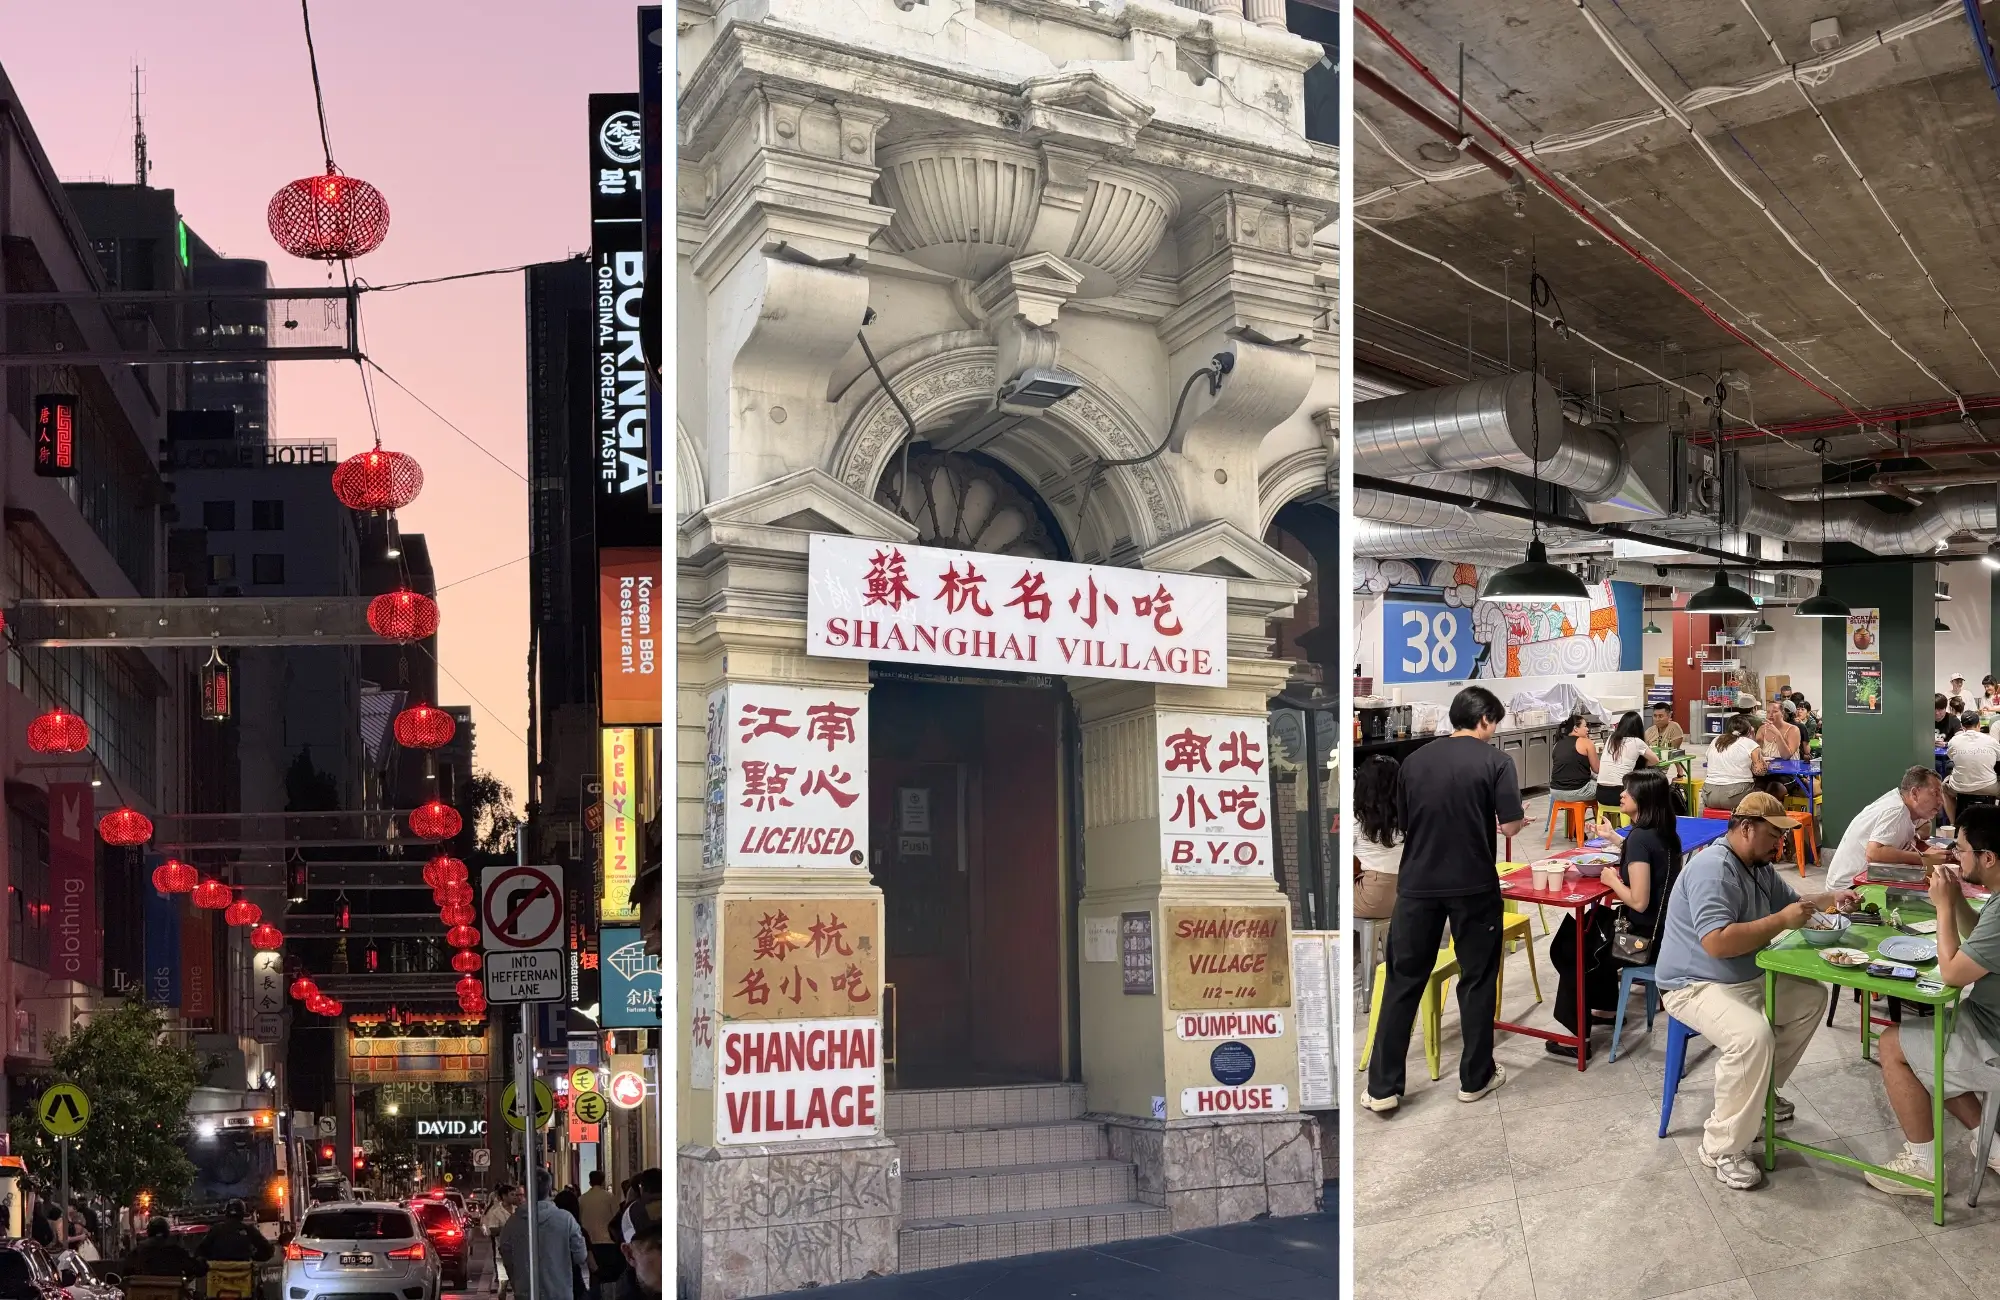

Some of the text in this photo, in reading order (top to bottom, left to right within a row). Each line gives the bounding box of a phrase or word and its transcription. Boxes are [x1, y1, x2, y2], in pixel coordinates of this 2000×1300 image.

[601, 352, 616, 420] KOREAN
[862, 547, 1184, 637] 蘇杭名小吃
[620, 576, 635, 674] Restaurant
[638, 576, 655, 674] Korean BBQ
[826, 617, 1213, 676] SHANGHAI VILLAGE
[1402, 610, 1458, 674] 38
[738, 701, 860, 752] 江南
[1165, 727, 1265, 775] 南北
[740, 761, 860, 812] 點心
[1169, 785, 1266, 831] 小吃
[740, 826, 855, 855] LICENSED
[902, 840, 929, 851] Push
[1171, 840, 1265, 866] B.Y.O.
[60, 878, 85, 972] clothing
[570, 914, 578, 949] crane
[752, 908, 854, 962] 蘇杭
[1175, 919, 1278, 938] SHANGHAI
[492, 969, 558, 983] HEFFERNAN
[511, 956, 537, 968] INTO
[570, 951, 580, 1002] restaurant
[732, 962, 872, 1005] 名小吃
[1189, 953, 1268, 975] VILLAGE
[153, 966, 170, 1005] kids
[188, 966, 202, 1013] home
[510, 984, 540, 996] LANE
[627, 988, 662, 1005] 余庆
[1184, 1014, 1277, 1037] DUMPLING
[725, 1028, 875, 1076] SHANGHAI
[726, 1085, 875, 1133] VILLAGE
[1198, 1088, 1273, 1112] HOUSE
[418, 1120, 466, 1135] DAVID
